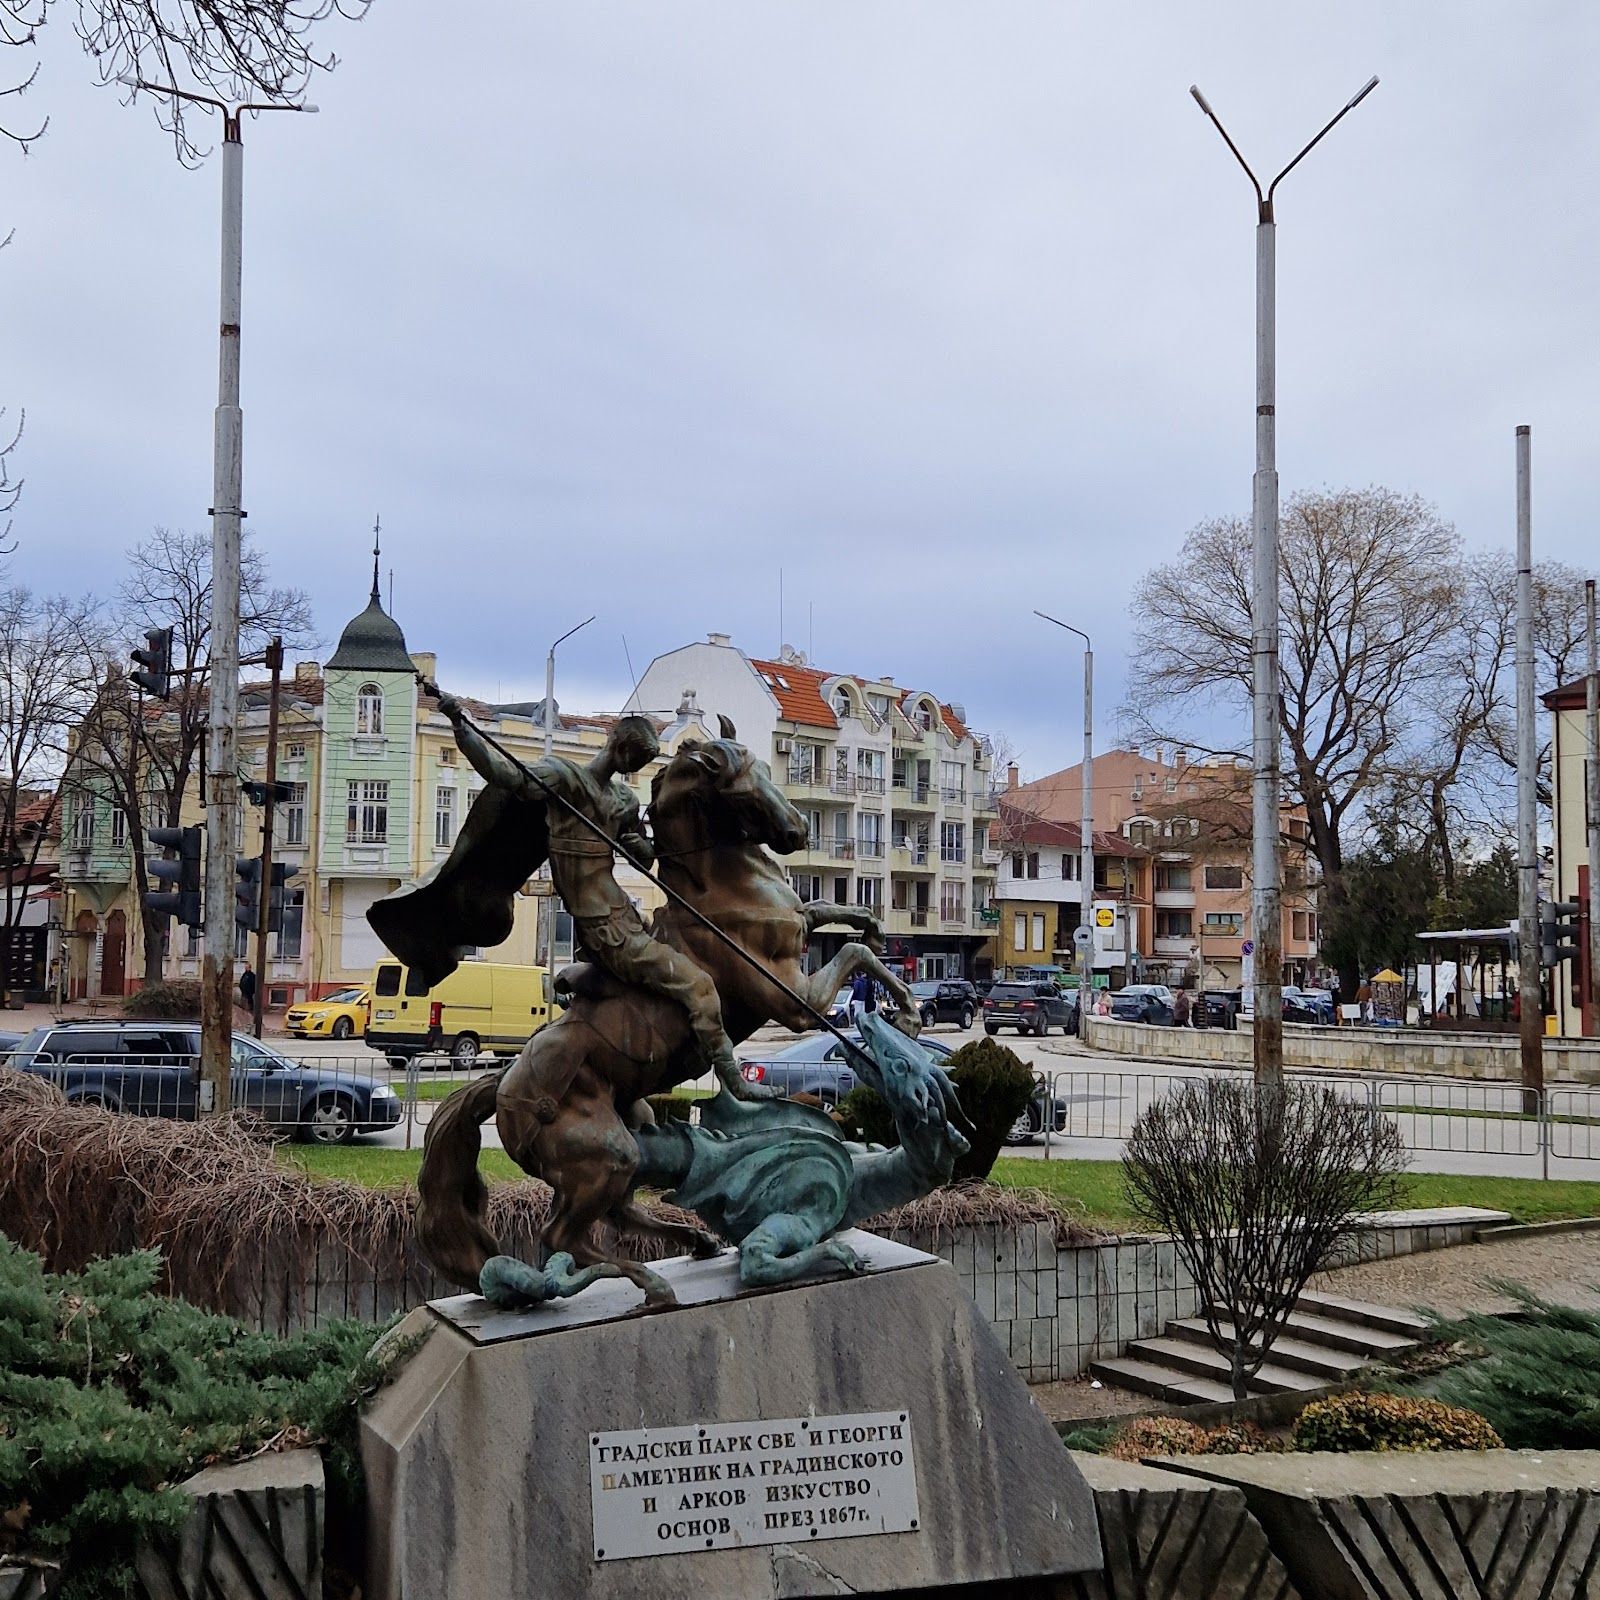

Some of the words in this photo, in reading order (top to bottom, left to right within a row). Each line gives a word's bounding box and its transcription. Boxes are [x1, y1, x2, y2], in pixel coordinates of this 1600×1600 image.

[599, 1440, 692, 1464] ГРАДСКИ
[698, 1436, 752, 1455] ПАРК
[828, 1425, 903, 1445] ГЕОРГИ
[602, 1464, 722, 1490] ПАМЕТНИК
[726, 1462, 755, 1479] НА
[760, 1450, 903, 1476] ГРАДИНСКОТО
[643, 1497, 658, 1514] И
[765, 1479, 871, 1503] ИЗКУСТВО
[764, 1510, 814, 1529] ПРЕЗ
[820, 1506, 870, 1525] 1867г.
